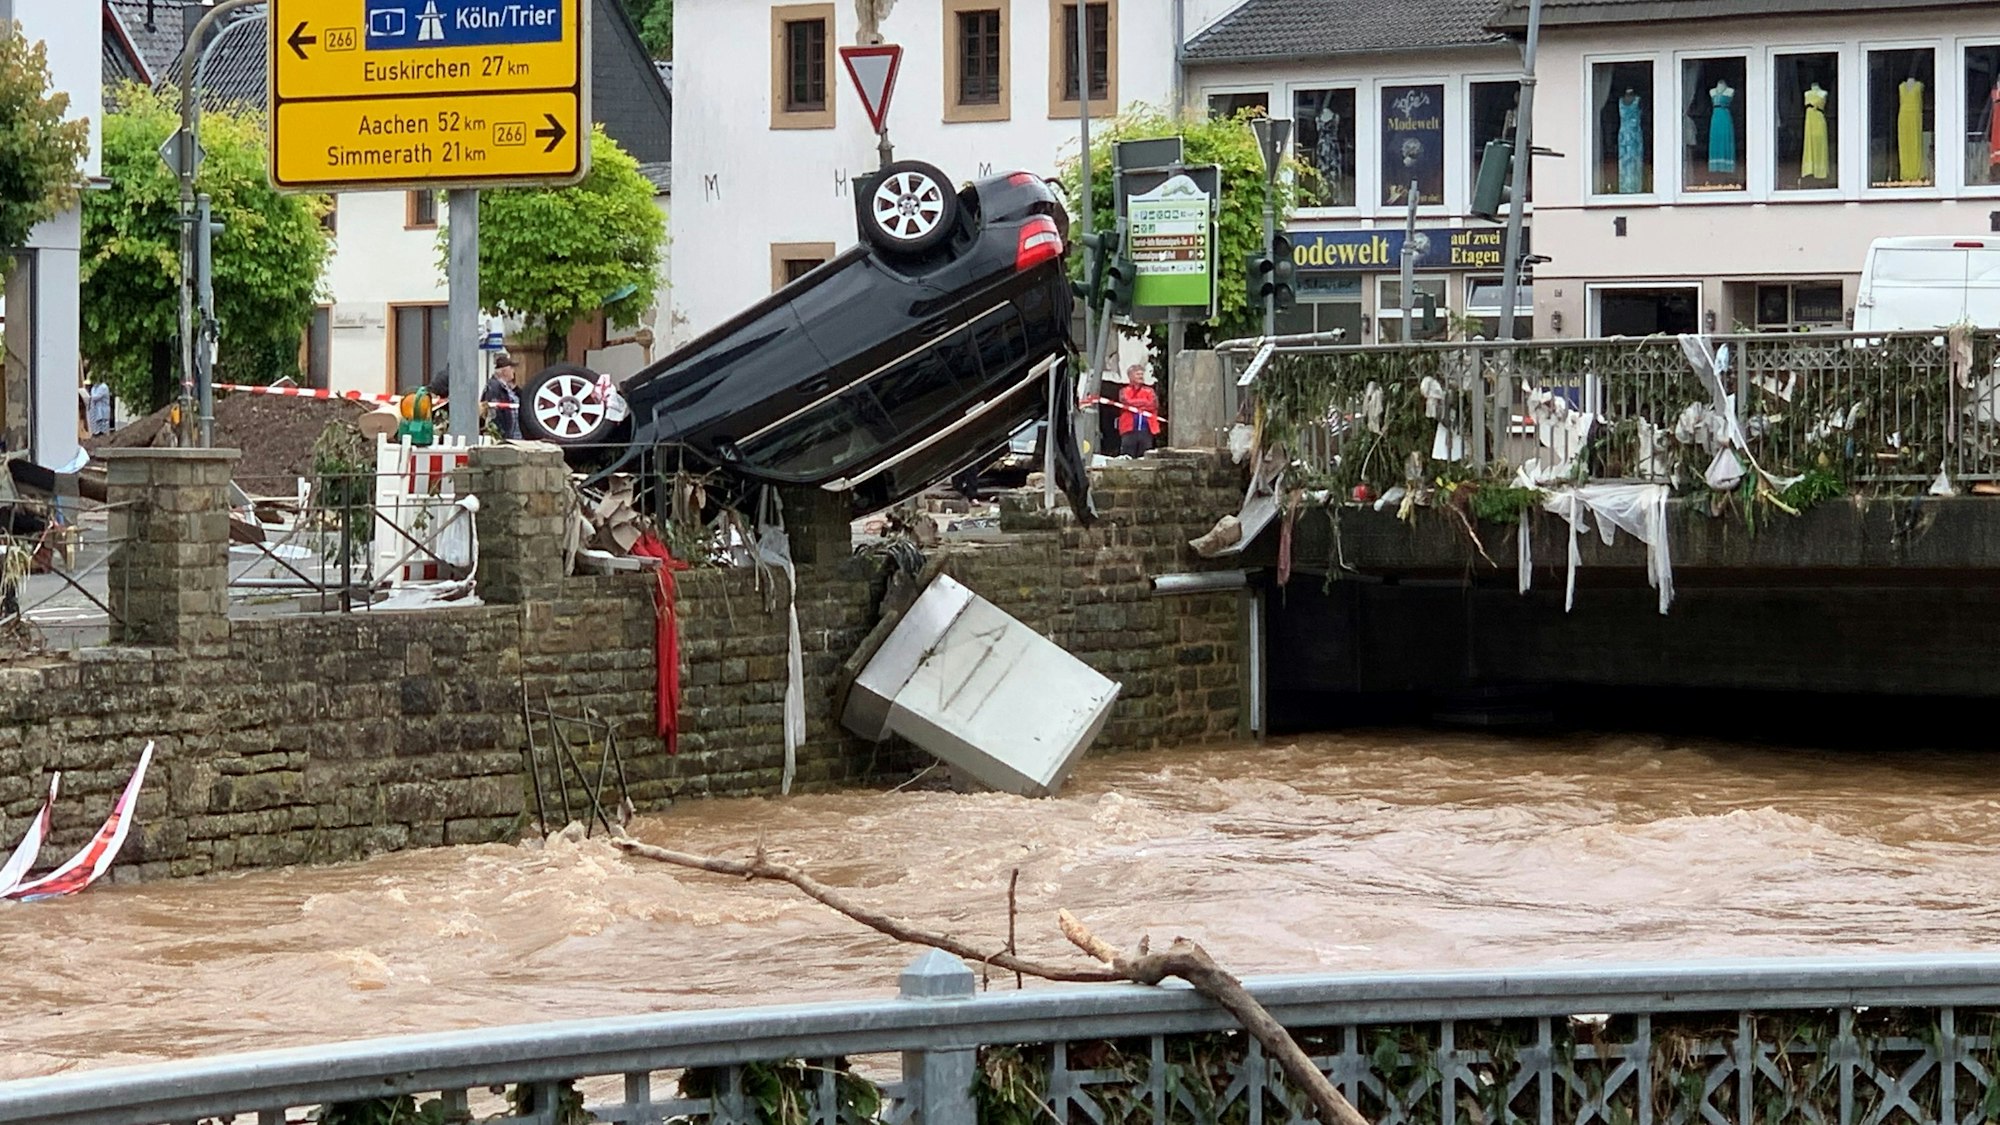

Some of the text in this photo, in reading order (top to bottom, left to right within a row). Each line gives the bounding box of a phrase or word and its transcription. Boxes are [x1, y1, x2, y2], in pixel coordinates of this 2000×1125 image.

[456, 4, 557, 30] Köln/Trier
[328, 31, 353, 48] 266
[364, 56, 530, 82] Euskirchen 27 km
[358, 112, 487, 135] Aachen 52 km
[1388, 117, 1439, 131] Modewelt
[497, 127, 522, 143] 266
[327, 142, 487, 167] Simmerath 21 km
[1450, 230, 1500, 246] auf zwei
[1293, 235, 1390, 266] odewelt
[1451, 248, 1500, 268] Etagen
